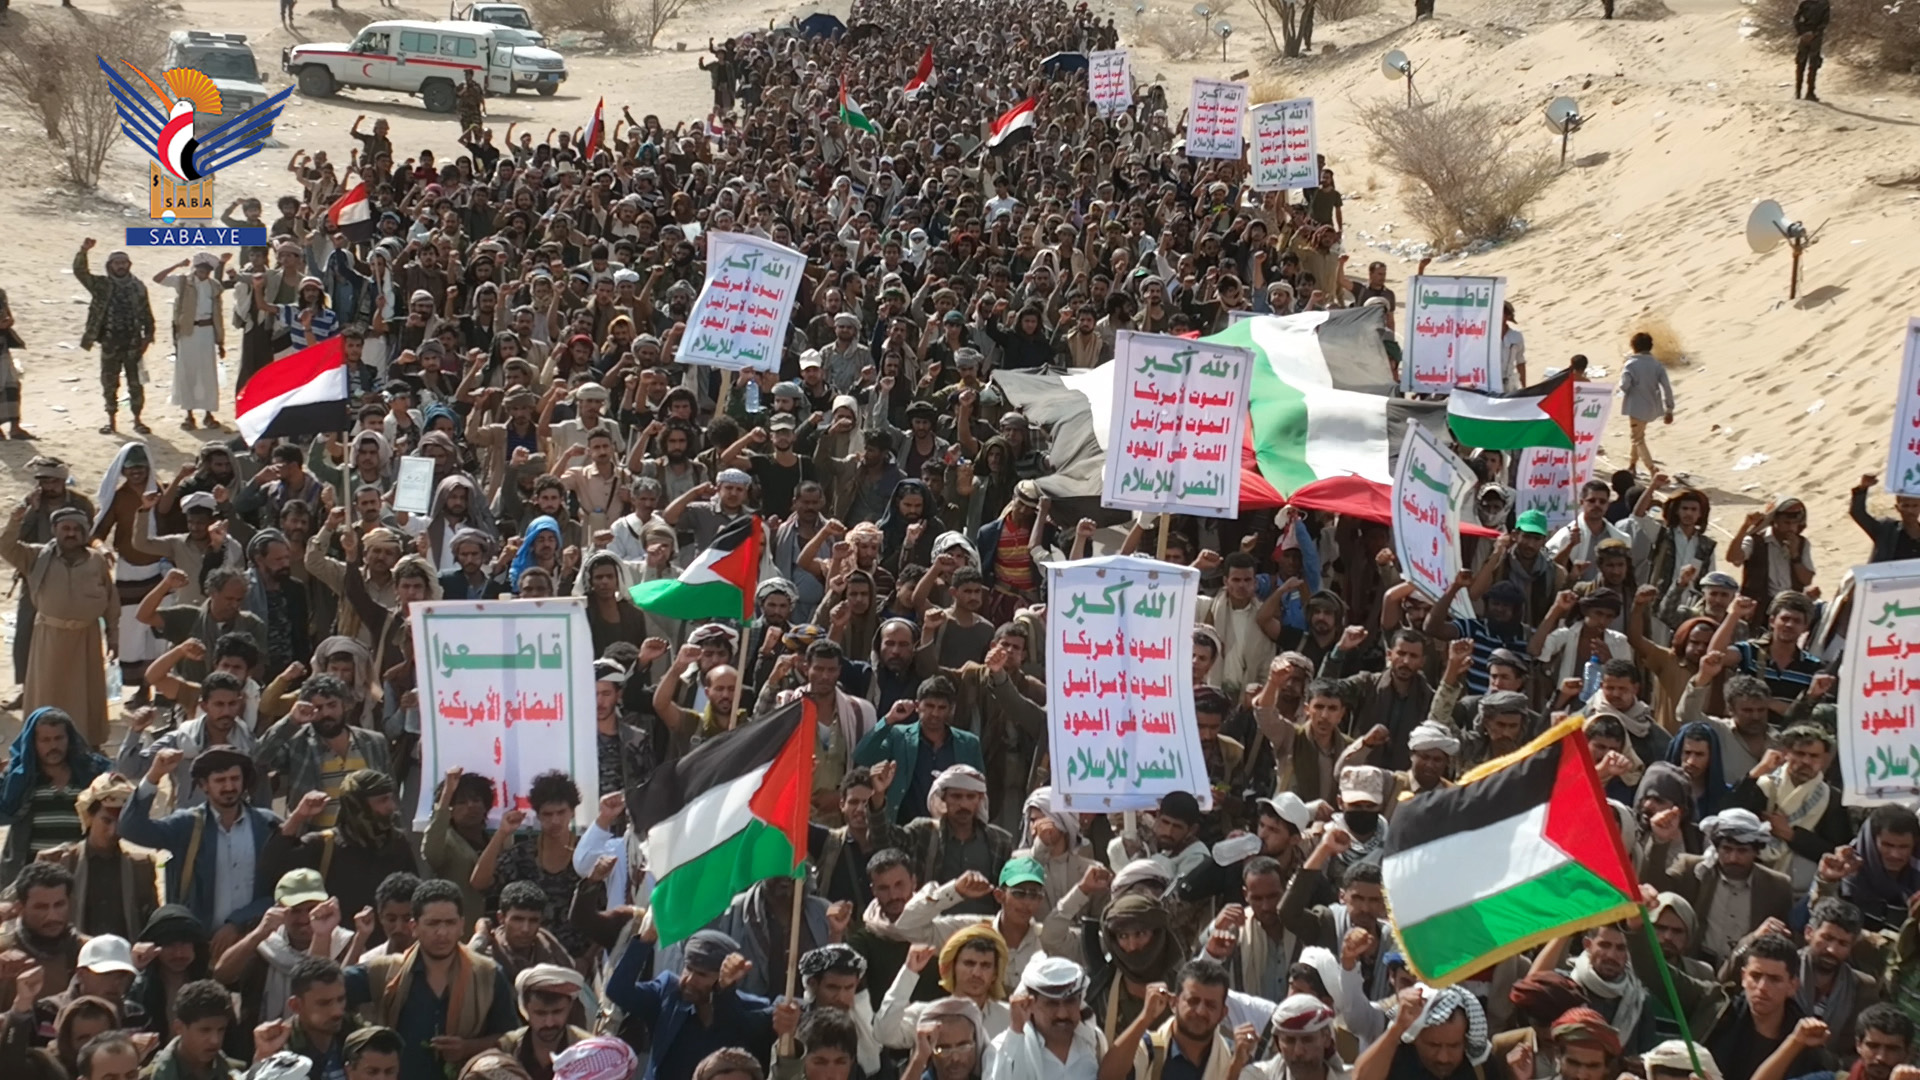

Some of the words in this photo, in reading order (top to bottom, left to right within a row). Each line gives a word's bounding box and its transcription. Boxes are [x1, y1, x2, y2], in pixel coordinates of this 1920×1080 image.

[1258, 106, 1288, 126] أكبر
[1288, 105, 1308, 120] الله
[1287, 125, 1309, 136] الموت
[1289, 165, 1312, 181] النصر
[719, 249, 764, 273] أكبر
[762, 256, 791, 280] الله
[752, 283, 784, 302] الموت
[1418, 284, 1490, 310] قاطعوا
[700, 315, 730, 332] اليهود
[748, 303, 778, 320] الموت
[730, 320, 747, 334] على
[750, 322, 774, 338] اللعنة
[1416, 315, 1454, 338] الأمريكية
[1455, 318, 1488, 339] البضائع
[691, 333, 734, 358] للإسلام
[732, 342, 770, 361] النصر
[1134, 346, 1200, 378] أكبر
[1200, 353, 1239, 380] الله
[1134, 380, 1186, 406] لأمريكا
[1189, 390, 1234, 409] الموت
[1130, 409, 1183, 437] لإسرائيل
[1186, 416, 1230, 436] الموت
[1126, 440, 1164, 462] اليهود
[1167, 443, 1188, 463] على
[1193, 444, 1226, 462] اللعنة
[1121, 466, 1176, 500] للإسلام
[1176, 470, 1224, 500] النصر
[1062, 575, 1134, 624] أكبر
[1133, 582, 1176, 619] الله
[433, 632, 563, 678] قاطعوا
[1063, 626, 1125, 660] لأمريكا
[1129, 636, 1172, 663] الموت
[1063, 668, 1127, 700] لإسرائيل
[1130, 675, 1172, 700] الموت
[438, 684, 500, 728] الأمريكية
[504, 690, 564, 728] البضائع
[1064, 707, 1110, 737] اليهود
[1116, 709, 1136, 737] على
[1141, 710, 1177, 735] اللعنة
[1862, 704, 1914, 735] اليهود
[494, 736, 502, 766] و
[1066, 746, 1128, 790] للإسلام
[1132, 746, 1184, 788] النصر
